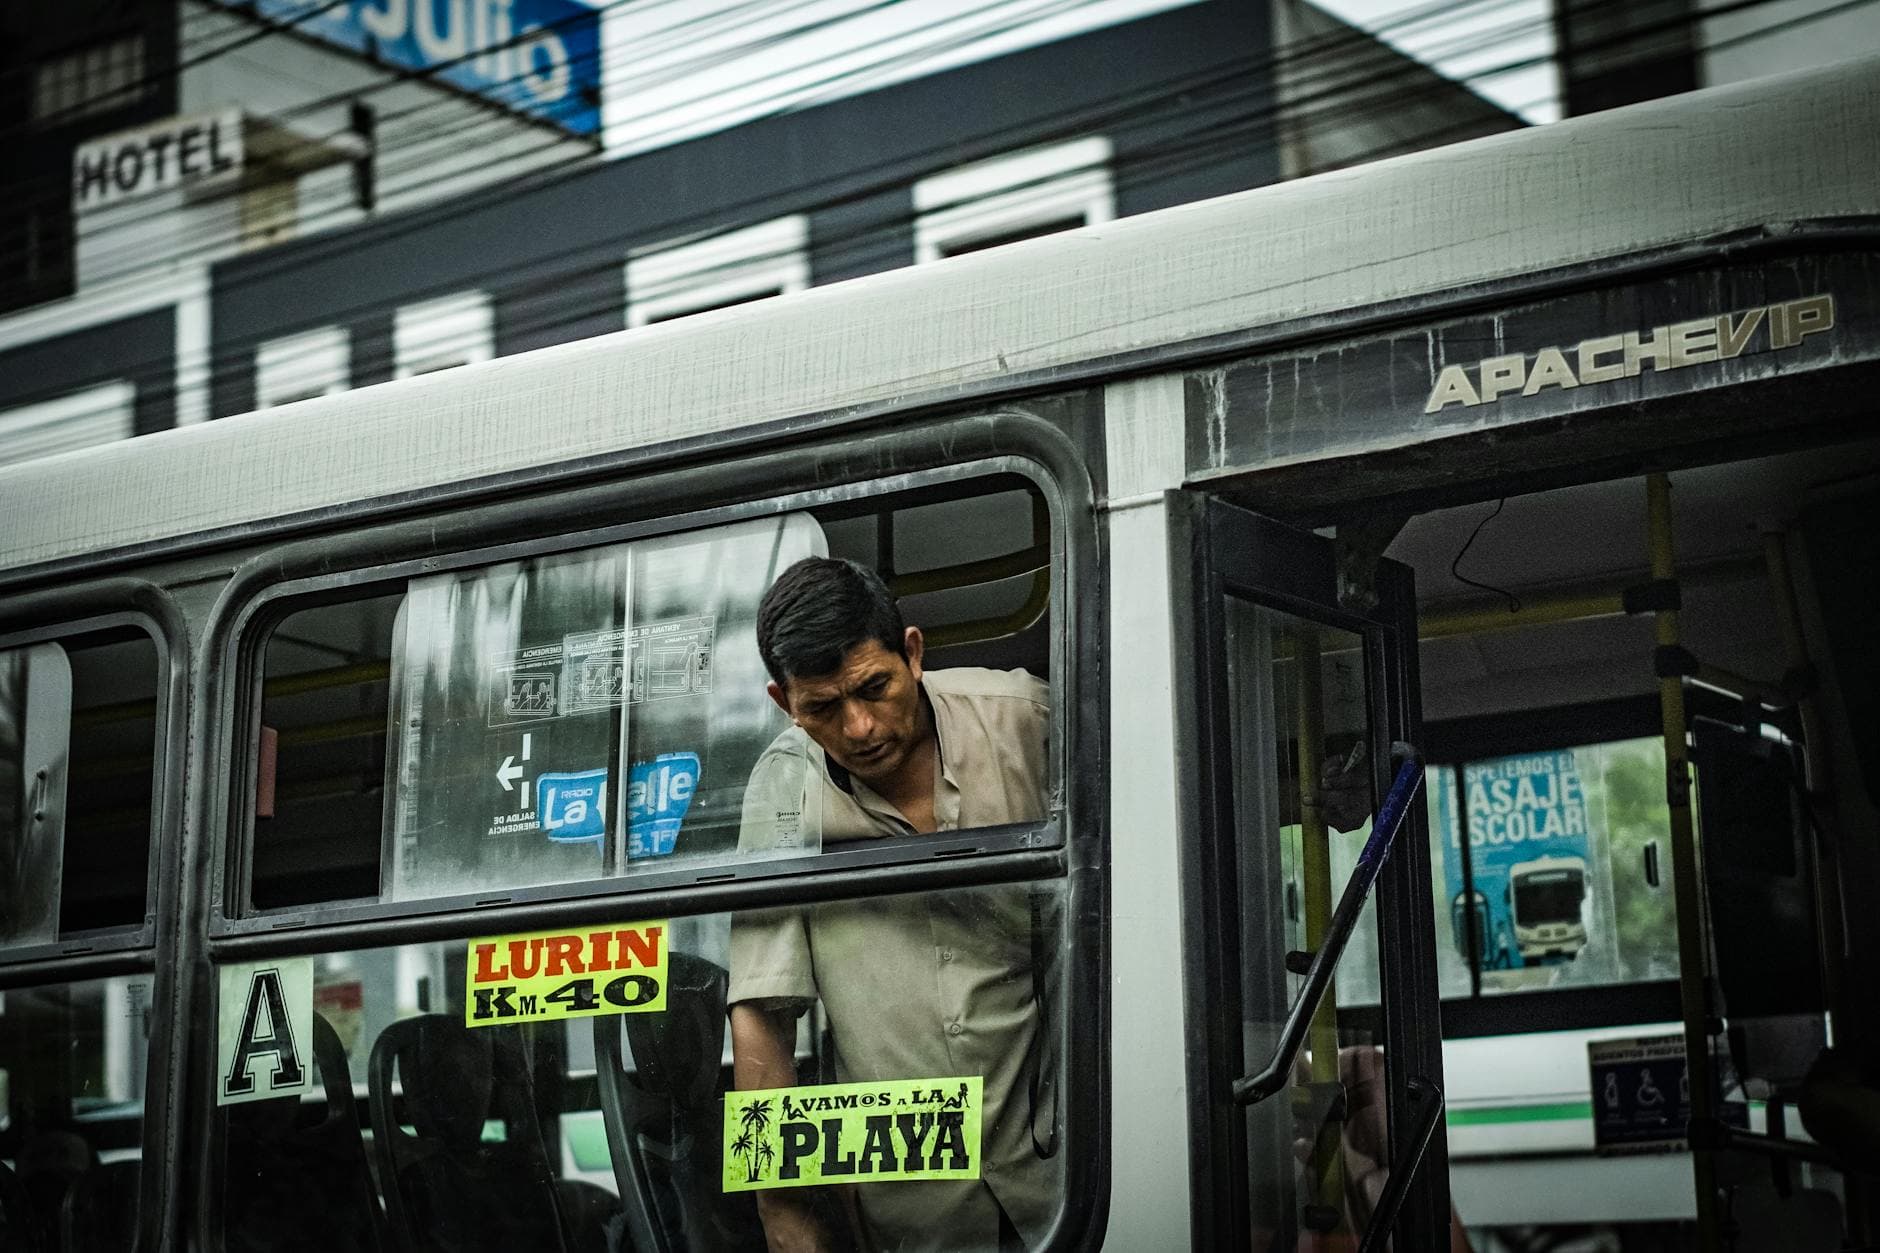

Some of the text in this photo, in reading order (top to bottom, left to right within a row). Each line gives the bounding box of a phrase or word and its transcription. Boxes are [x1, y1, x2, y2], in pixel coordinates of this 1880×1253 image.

[80, 122, 233, 199] HOTEL
[544, 787, 588, 831] La
[560, 788, 594, 800] RADIO
[474, 926, 663, 983] LURIN
[224, 968, 305, 1097] A
[800, 1092, 892, 1112] VAMOS
[911, 1089, 946, 1105] LA
[779, 1111, 970, 1180] PLAYA
